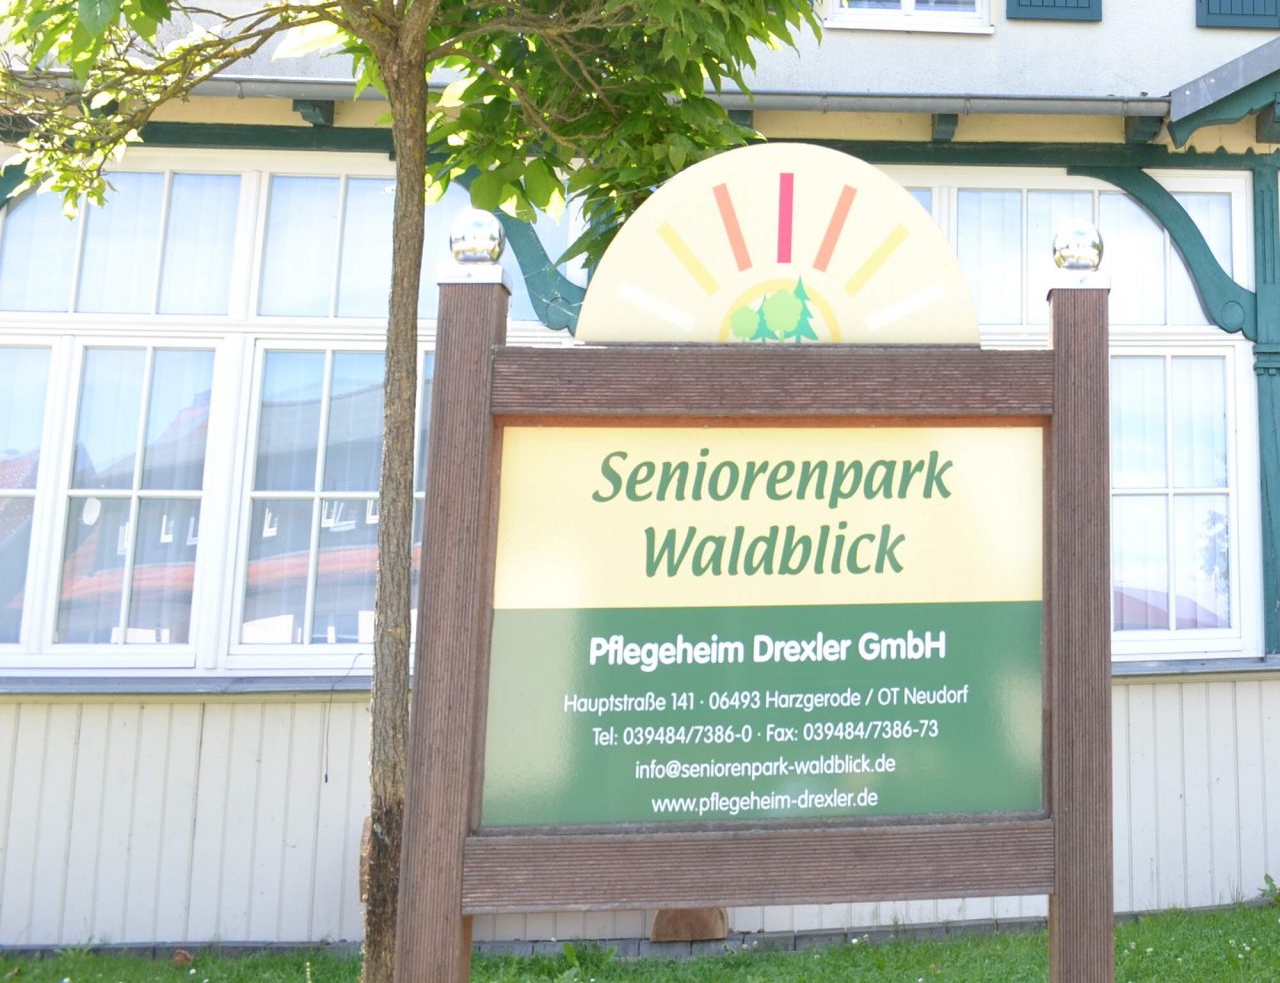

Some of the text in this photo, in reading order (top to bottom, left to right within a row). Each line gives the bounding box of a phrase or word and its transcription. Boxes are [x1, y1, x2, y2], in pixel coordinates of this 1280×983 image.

[591, 447, 953, 510] Seniorenpark
[644, 520, 906, 578] Waldblick
[589, 629, 946, 673] Pflegeheim Drexler GmbH
[563, 691, 667, 717] Hauptstraße
[671, 692, 694, 711] 141
[708, 690, 761, 710] 06493
[765, 687, 862, 713] Harzgerode
[865, 688, 874, 706] /
[877, 687, 900, 706] OT
[903, 684, 969, 705] Neudorf
[592, 727, 618, 746] Tel:
[622, 724, 753, 746] 039484/7386-0
[766, 723, 798, 742] Fax:
[802, 719, 939, 742] 039484/7386-73
[635, 753, 896, 781] info@seniorenpark-waldblick.de
[651, 786, 879, 816] www.pflegeheim-drexler.de
